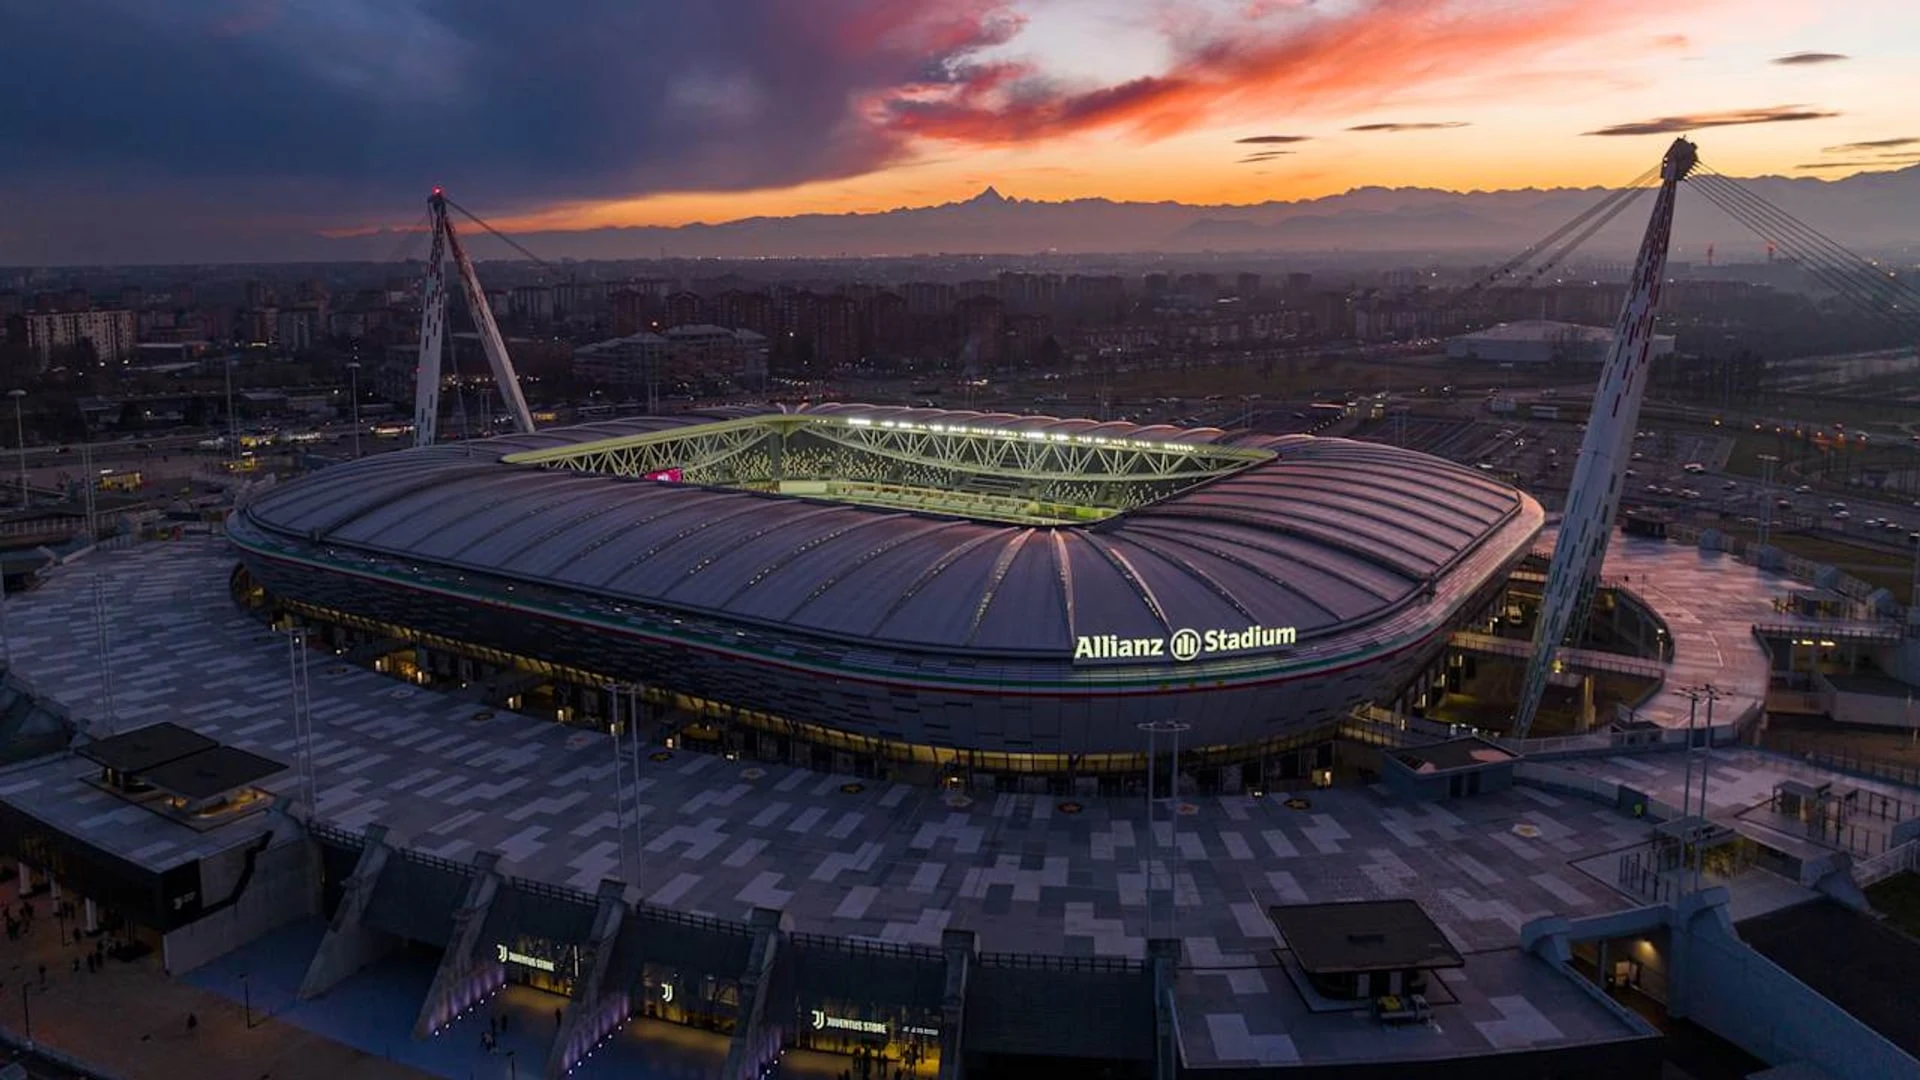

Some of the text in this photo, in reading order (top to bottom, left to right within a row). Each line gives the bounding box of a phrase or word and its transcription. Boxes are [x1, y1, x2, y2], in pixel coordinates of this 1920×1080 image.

[1074, 625, 1296, 659] Allianz Stadium
[863, 1021, 887, 1034] STORE
